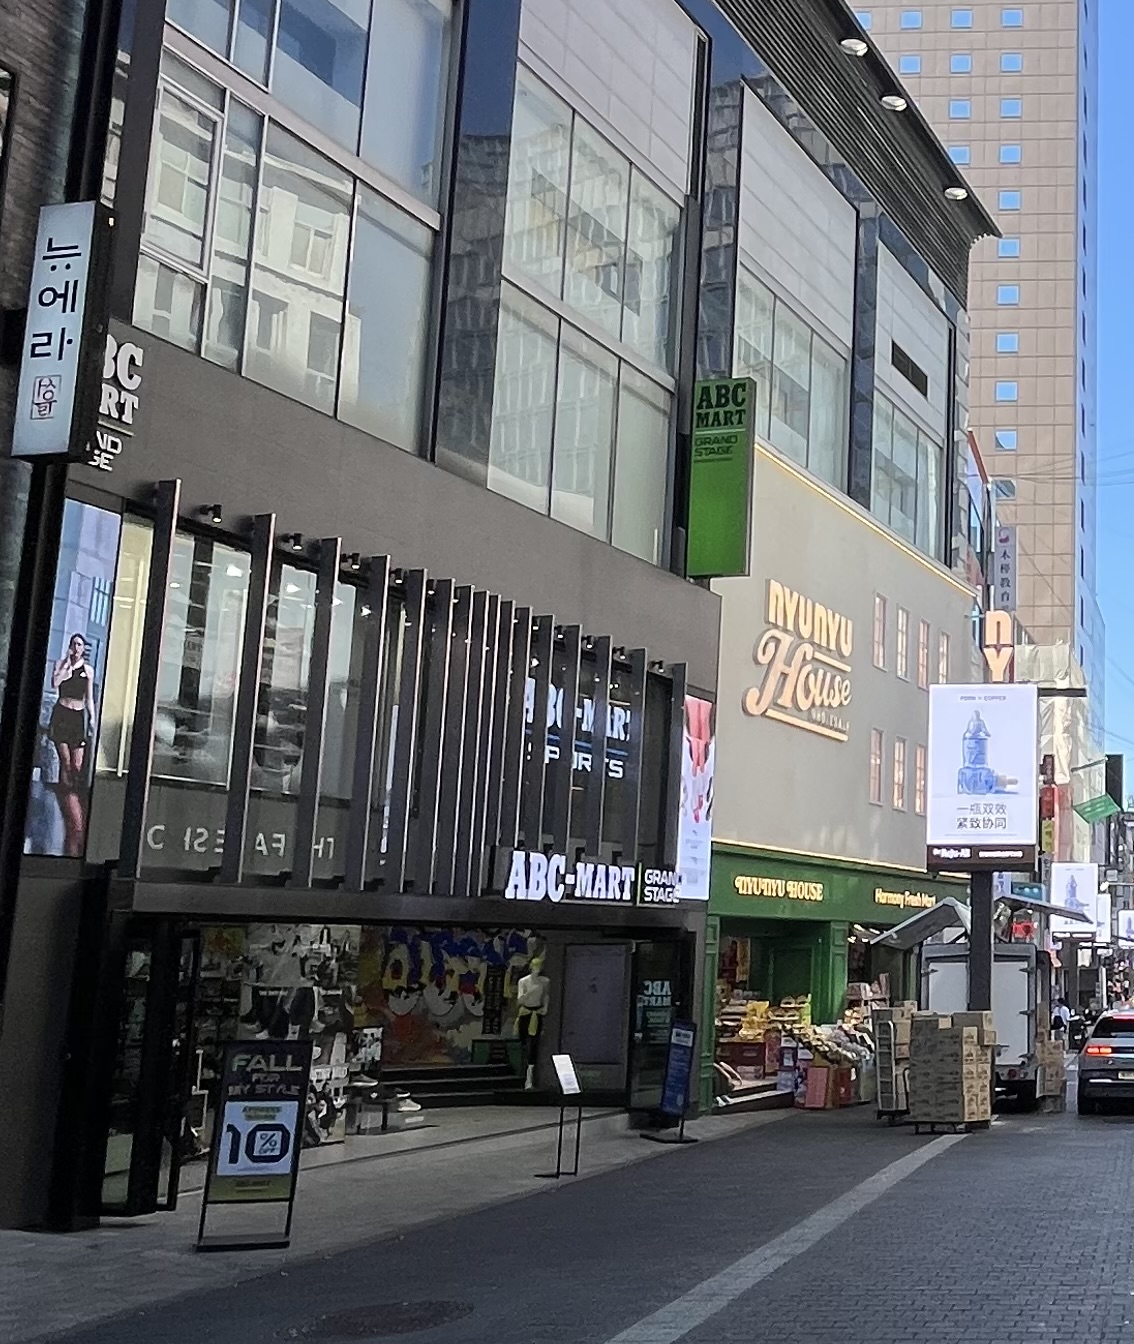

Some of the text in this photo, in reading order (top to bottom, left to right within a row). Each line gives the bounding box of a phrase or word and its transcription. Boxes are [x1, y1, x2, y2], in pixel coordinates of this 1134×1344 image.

[102, 334, 144, 391] BC
[98, 383, 141, 426] RT
[696, 382, 747, 410] ABC
[695, 409, 746, 429] MART
[693, 445, 734, 457] STAGE
[694, 434, 738, 447] GRAND
[504, 850, 683, 903] ABC-MART GRAND STAGE
[232, 1054, 303, 1072] FALL
